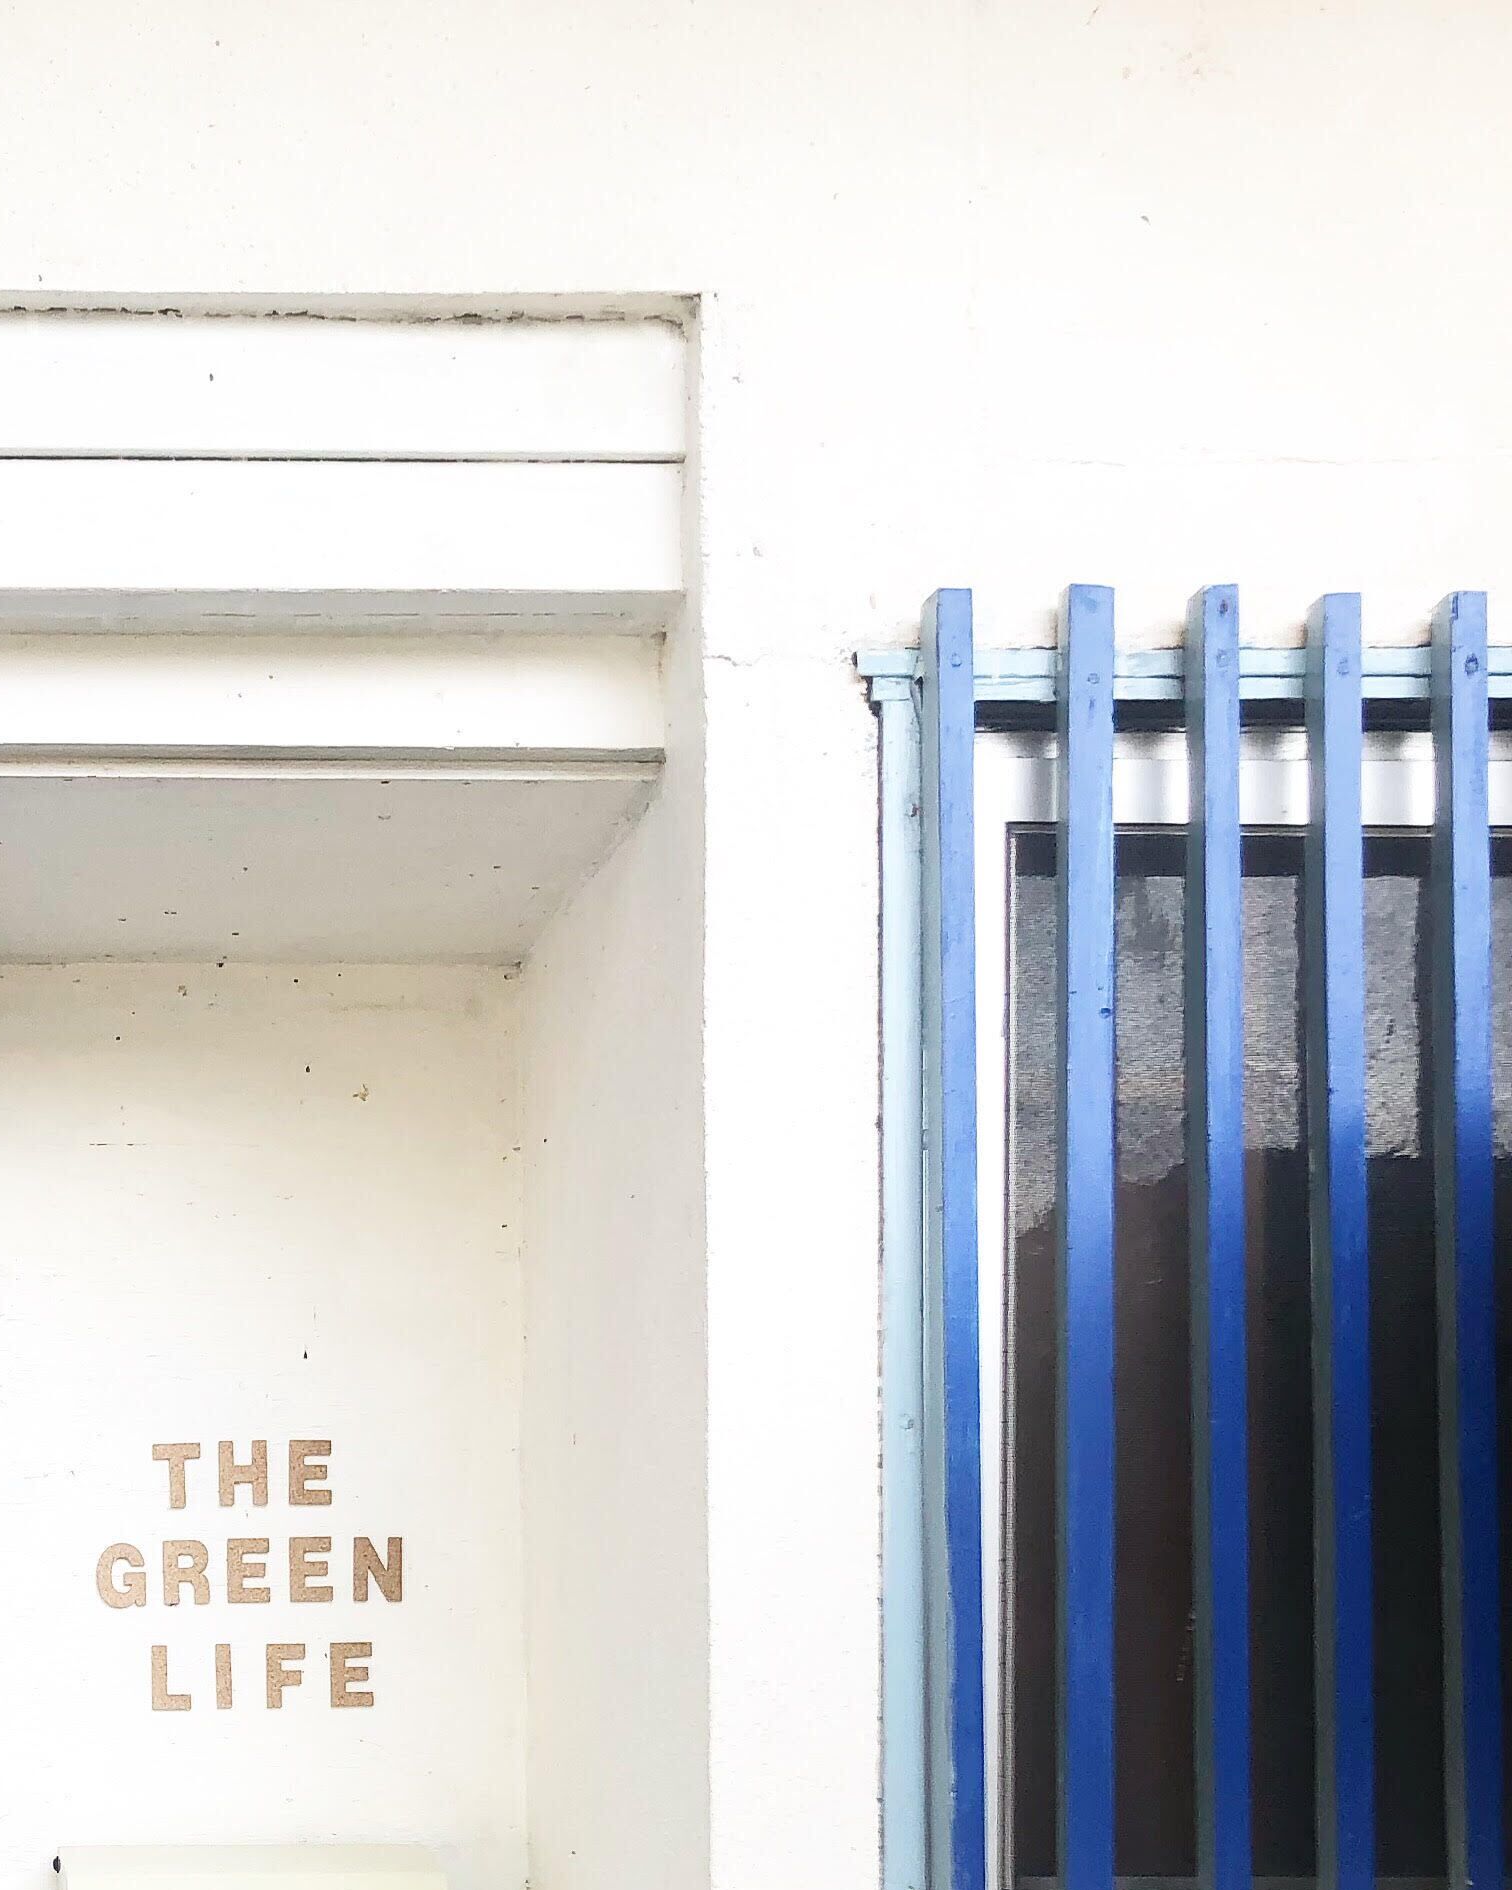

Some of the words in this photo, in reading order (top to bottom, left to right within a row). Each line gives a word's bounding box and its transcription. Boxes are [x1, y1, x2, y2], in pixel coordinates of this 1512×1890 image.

[152, 1440, 332, 1509] THE
[96, 1536, 403, 1609] GREEN
[151, 1642, 375, 1711] LIFE
